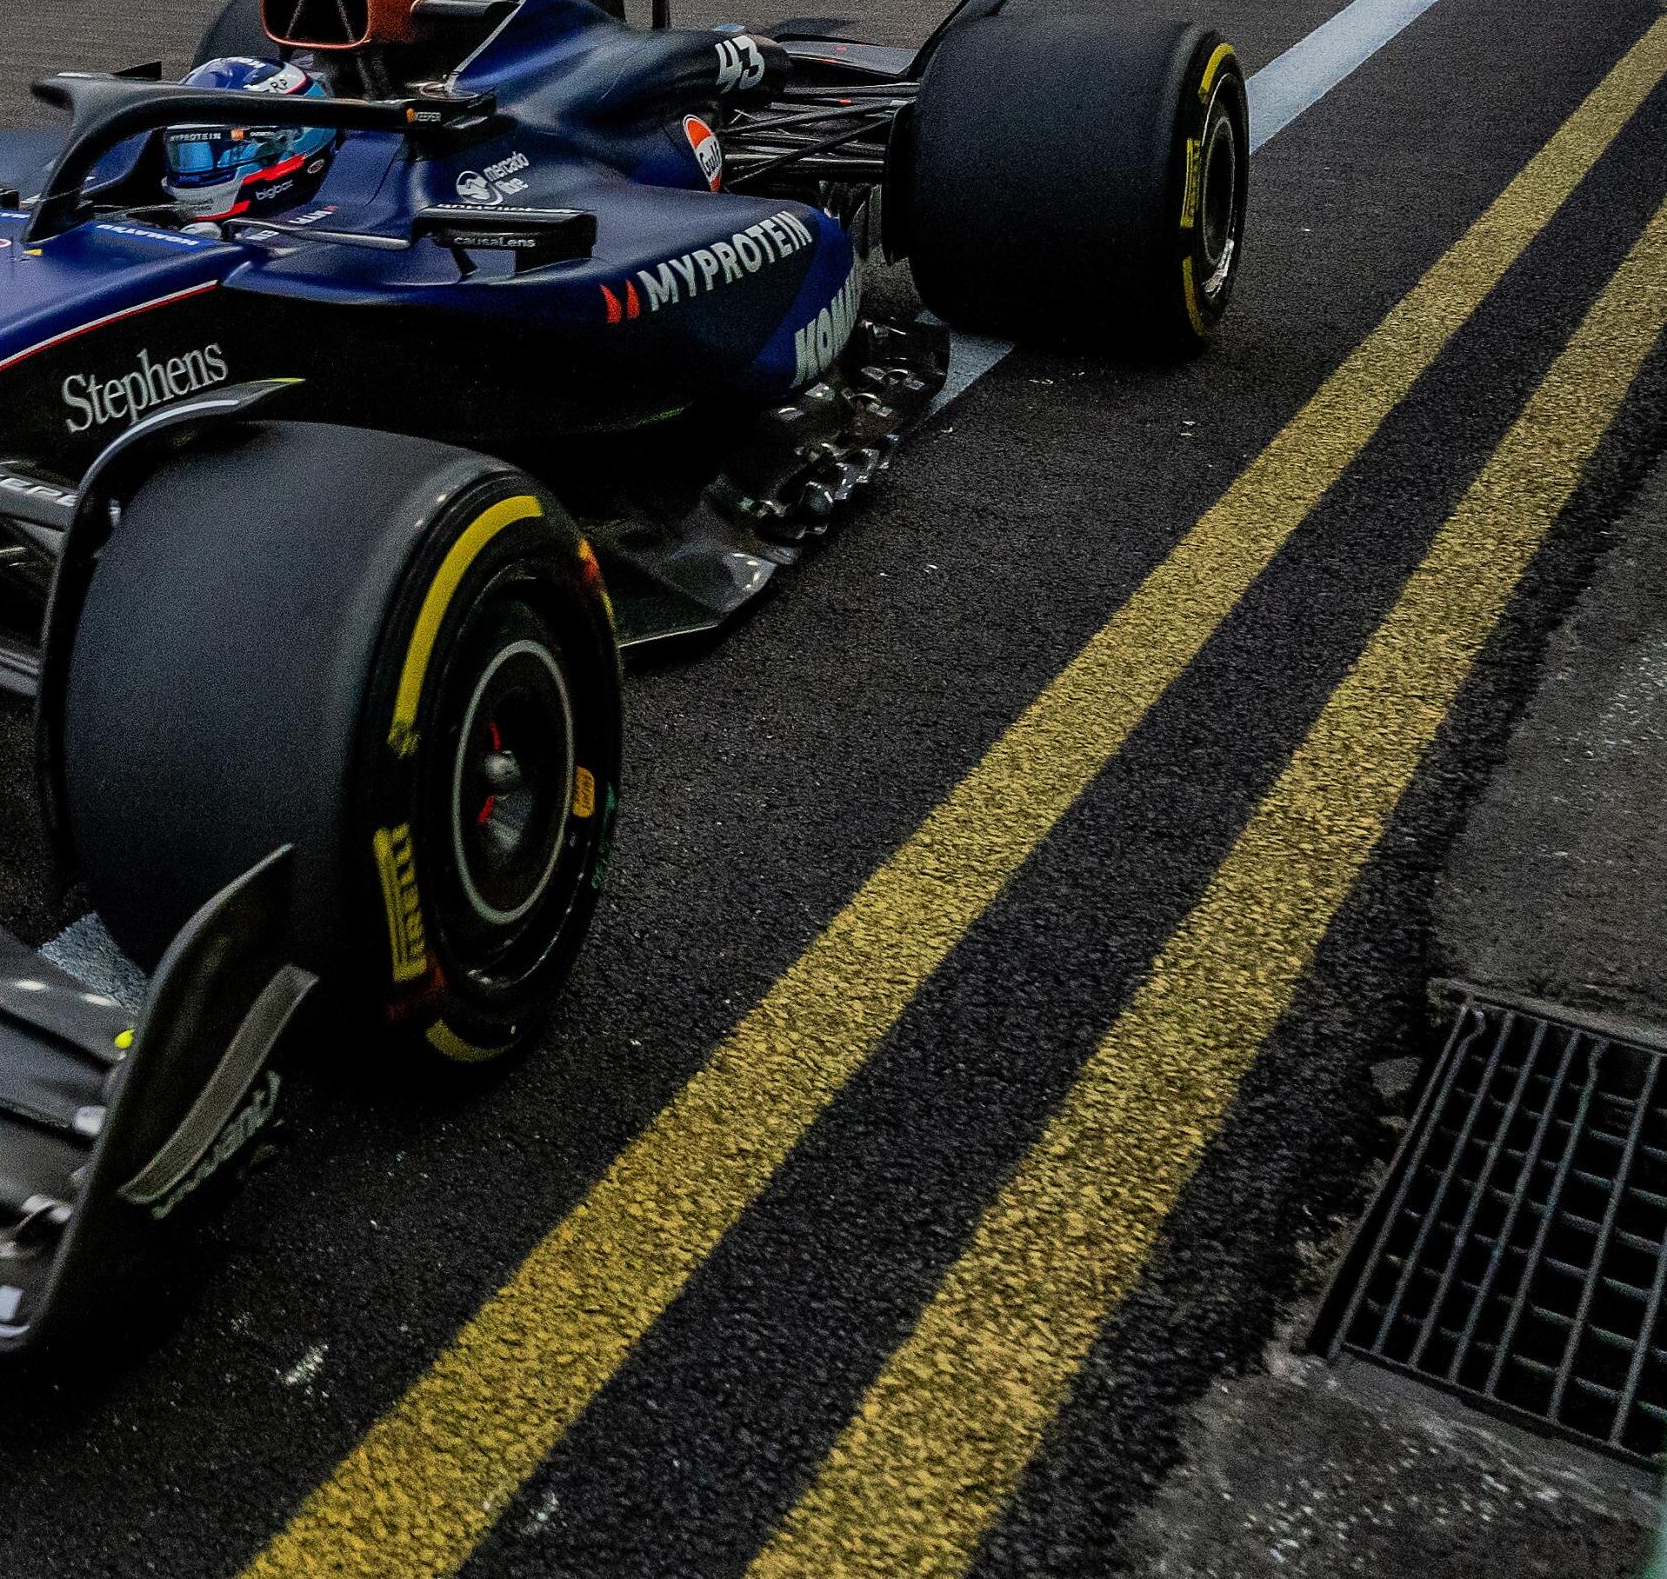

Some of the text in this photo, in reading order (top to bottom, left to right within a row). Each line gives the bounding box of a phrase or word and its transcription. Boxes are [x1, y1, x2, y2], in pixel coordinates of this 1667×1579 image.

[713, 34, 766, 96] 43
[483, 150, 530, 182] mercado
[255, 179, 294, 201] bigbox
[453, 236, 537, 248] causaLens
[636, 210, 813, 312] MYPROTEIN
[61, 339, 229, 433] Stephens
